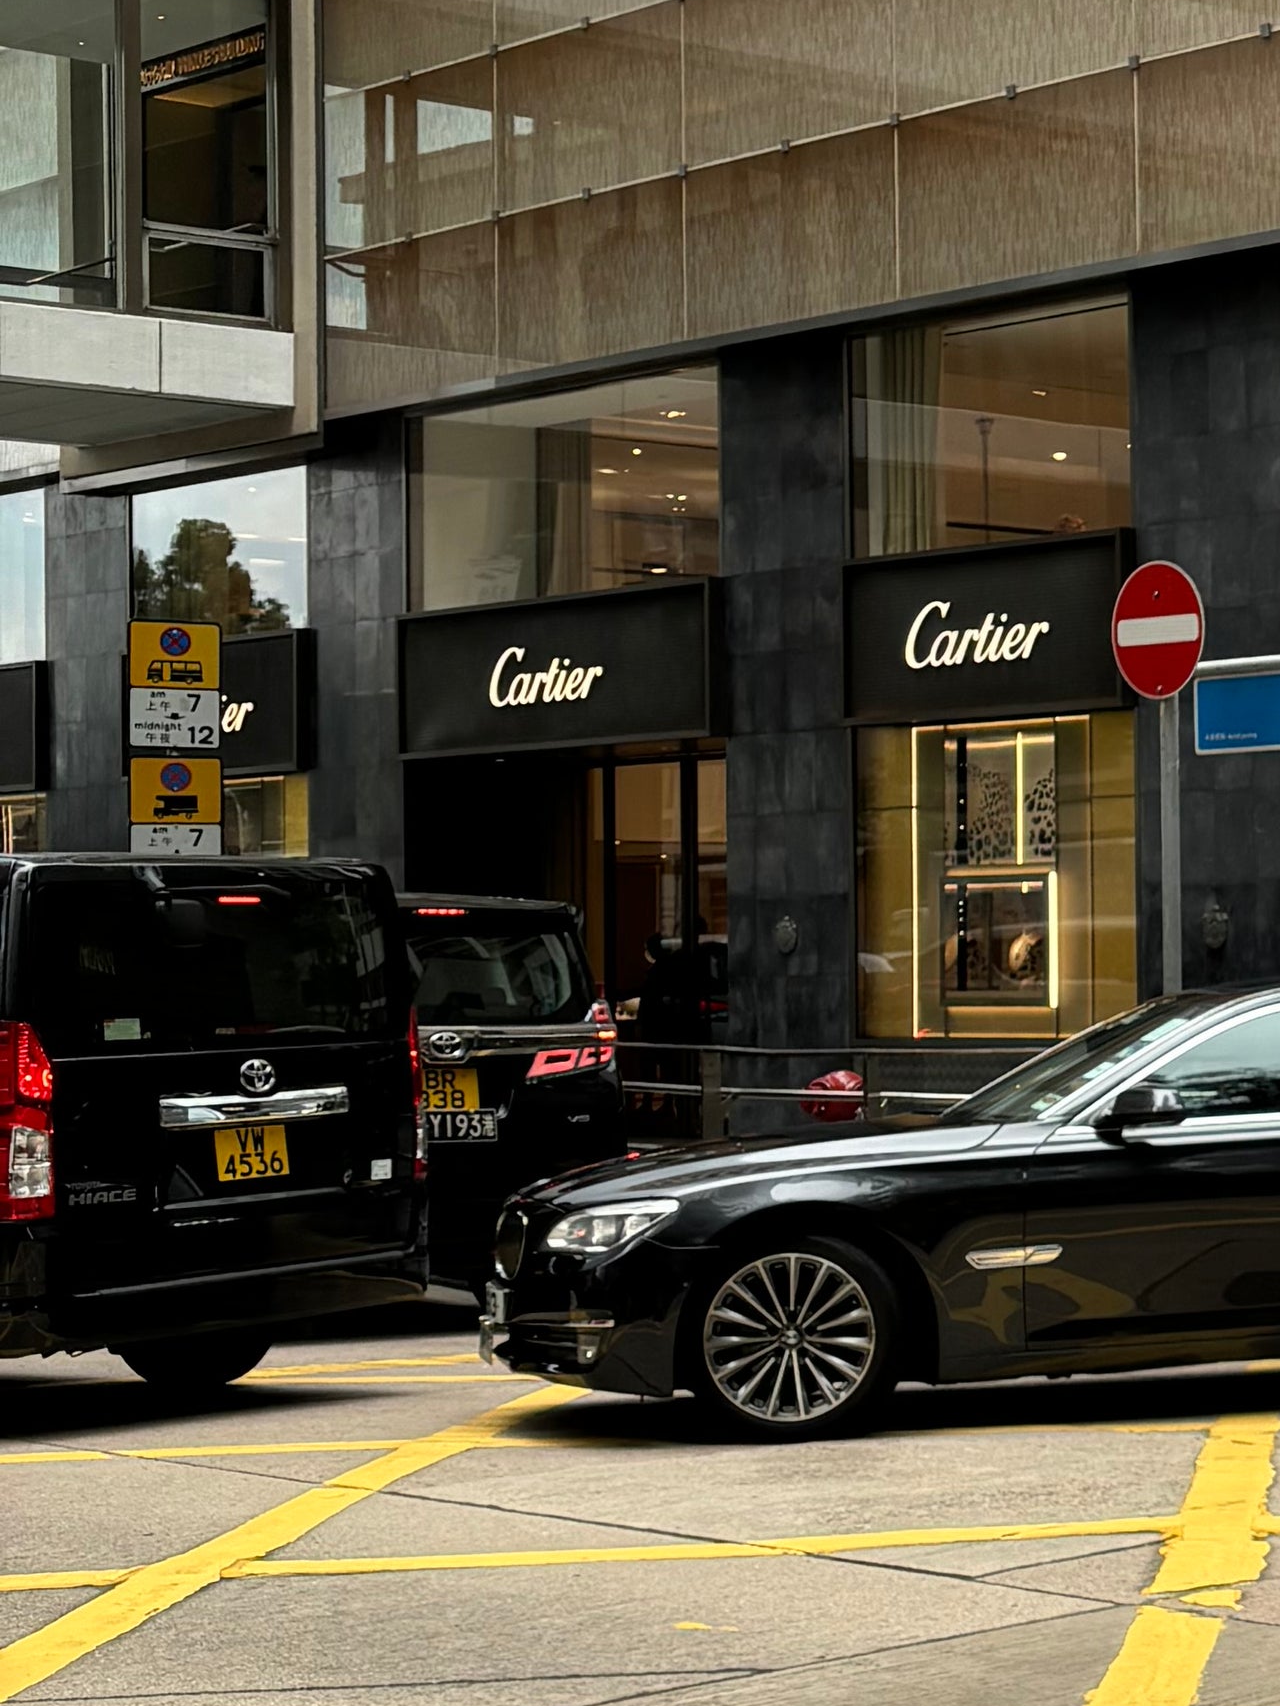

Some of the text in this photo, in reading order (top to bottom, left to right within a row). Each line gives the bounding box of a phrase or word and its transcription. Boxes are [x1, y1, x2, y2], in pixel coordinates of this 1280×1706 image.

[905, 600, 1050, 669] Cartier
[489, 646, 603, 708] Cartier
[145, 700, 171, 712] 上午
[187, 693, 201, 712] 7
[134, 721, 182, 732] midnight
[187, 725, 214, 745] 12
[189, 828, 203, 847] 7
[425, 1069, 456, 1089] BR
[235, 1127, 264, 1153] VW
[224, 1150, 284, 1179] 4536
[68, 1188, 137, 1206] HIACE
